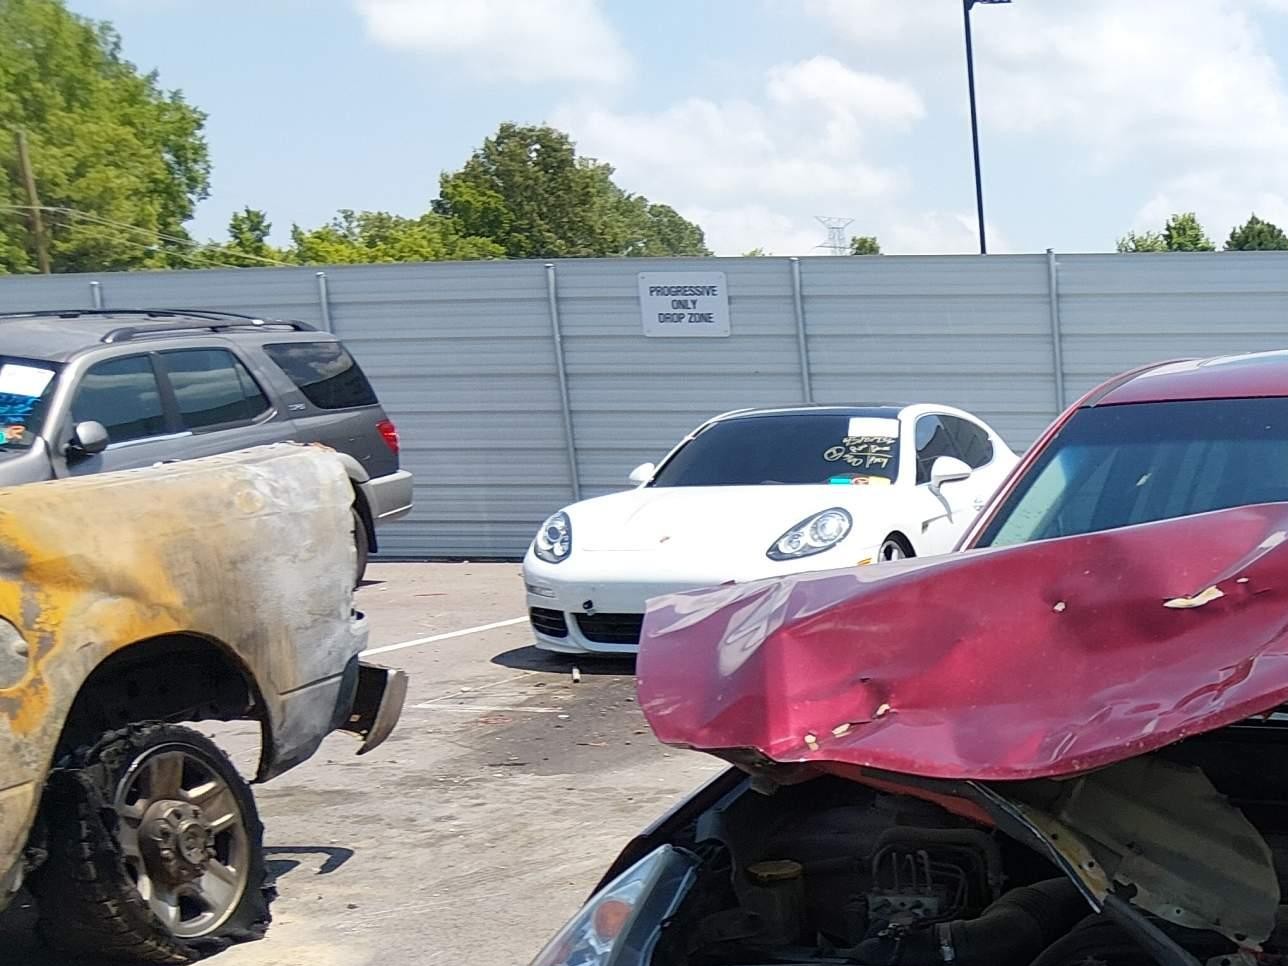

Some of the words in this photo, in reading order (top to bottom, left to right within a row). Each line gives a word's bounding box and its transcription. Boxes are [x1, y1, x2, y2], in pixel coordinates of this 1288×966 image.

[649, 285, 718, 296] PROGRESSIVE
[671, 299, 697, 309] ONLY
[658, 312, 685, 323] DROP
[688, 312, 714, 323] ZONE
